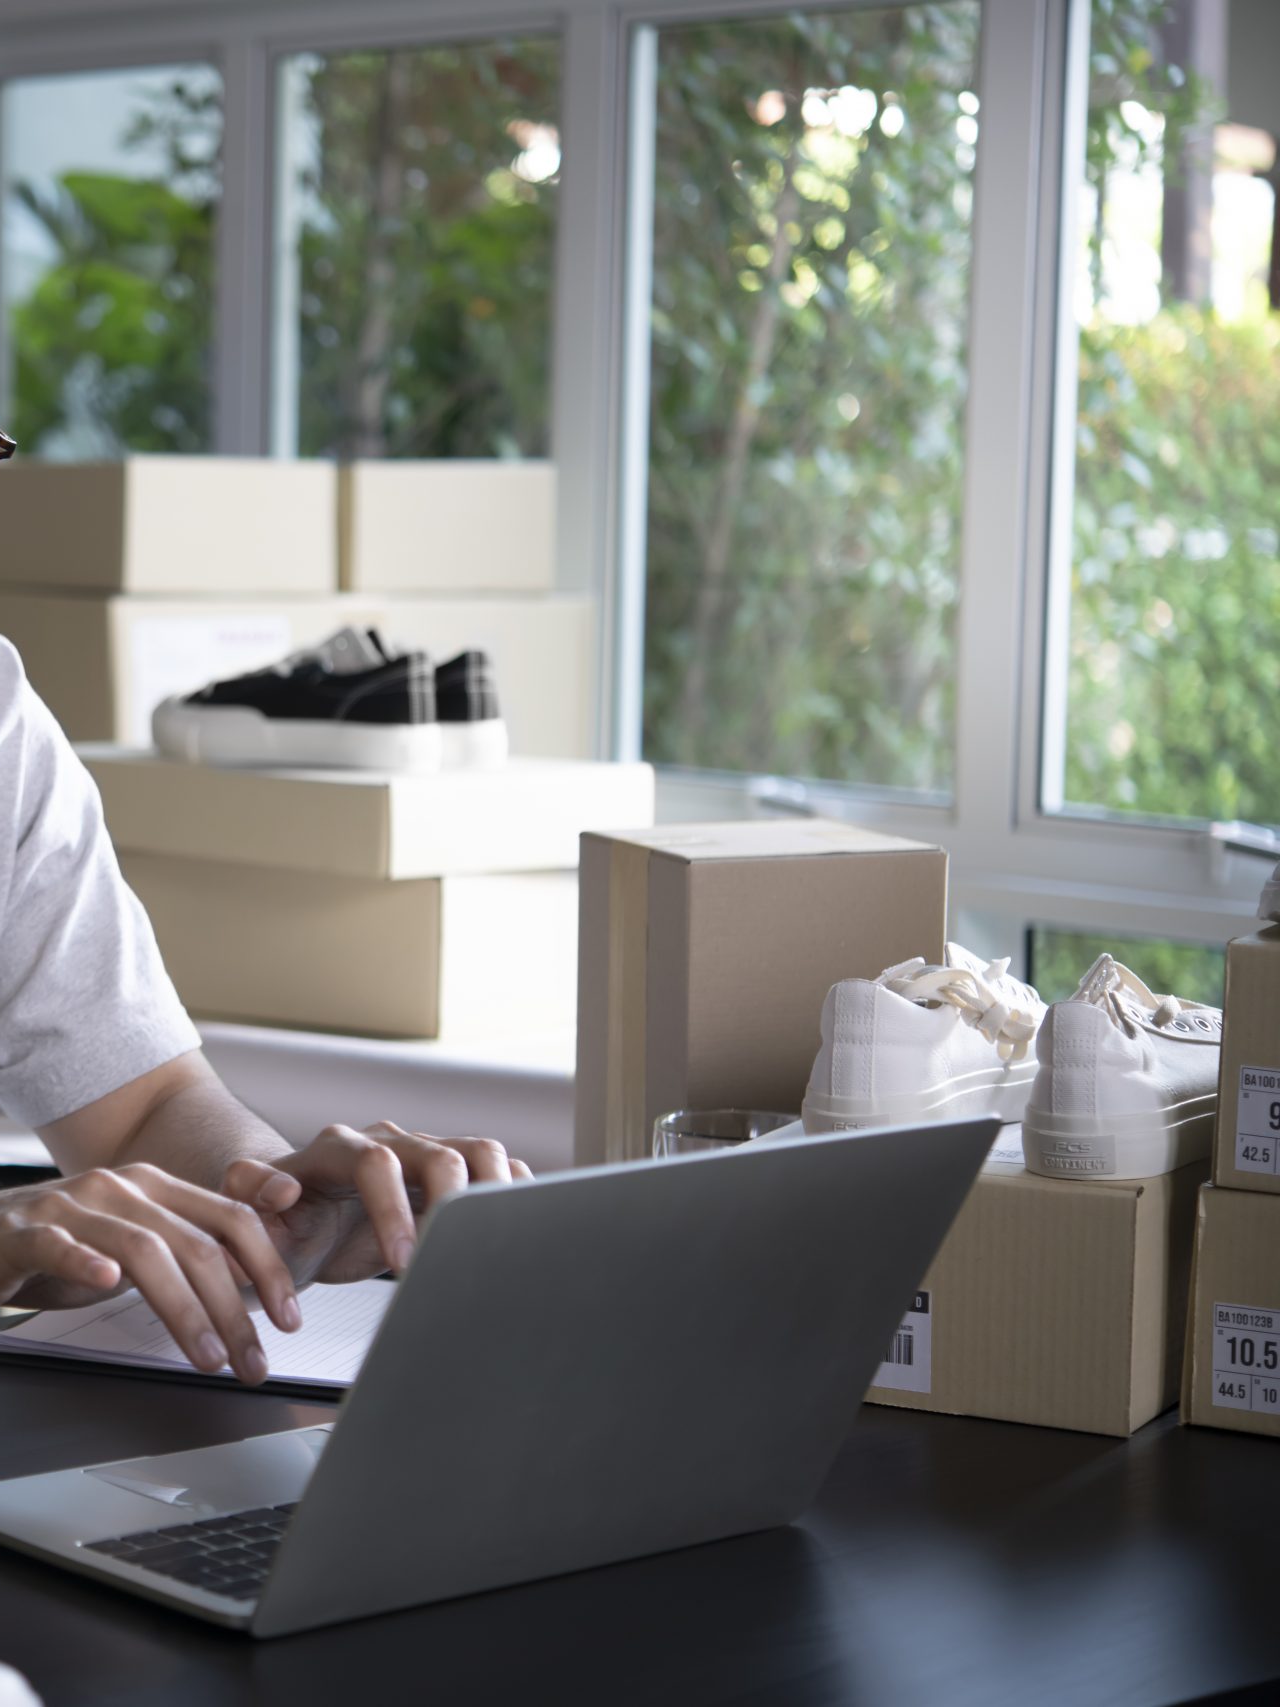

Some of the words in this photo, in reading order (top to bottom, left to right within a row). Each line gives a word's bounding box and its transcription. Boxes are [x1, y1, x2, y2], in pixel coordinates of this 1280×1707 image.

[1242, 1146, 1270, 1163] 42.5
[1226, 1336, 1278, 1370] 10.5
[1218, 1382, 1246, 1400] 44.5
[1262, 1387, 1277, 1404] 10
